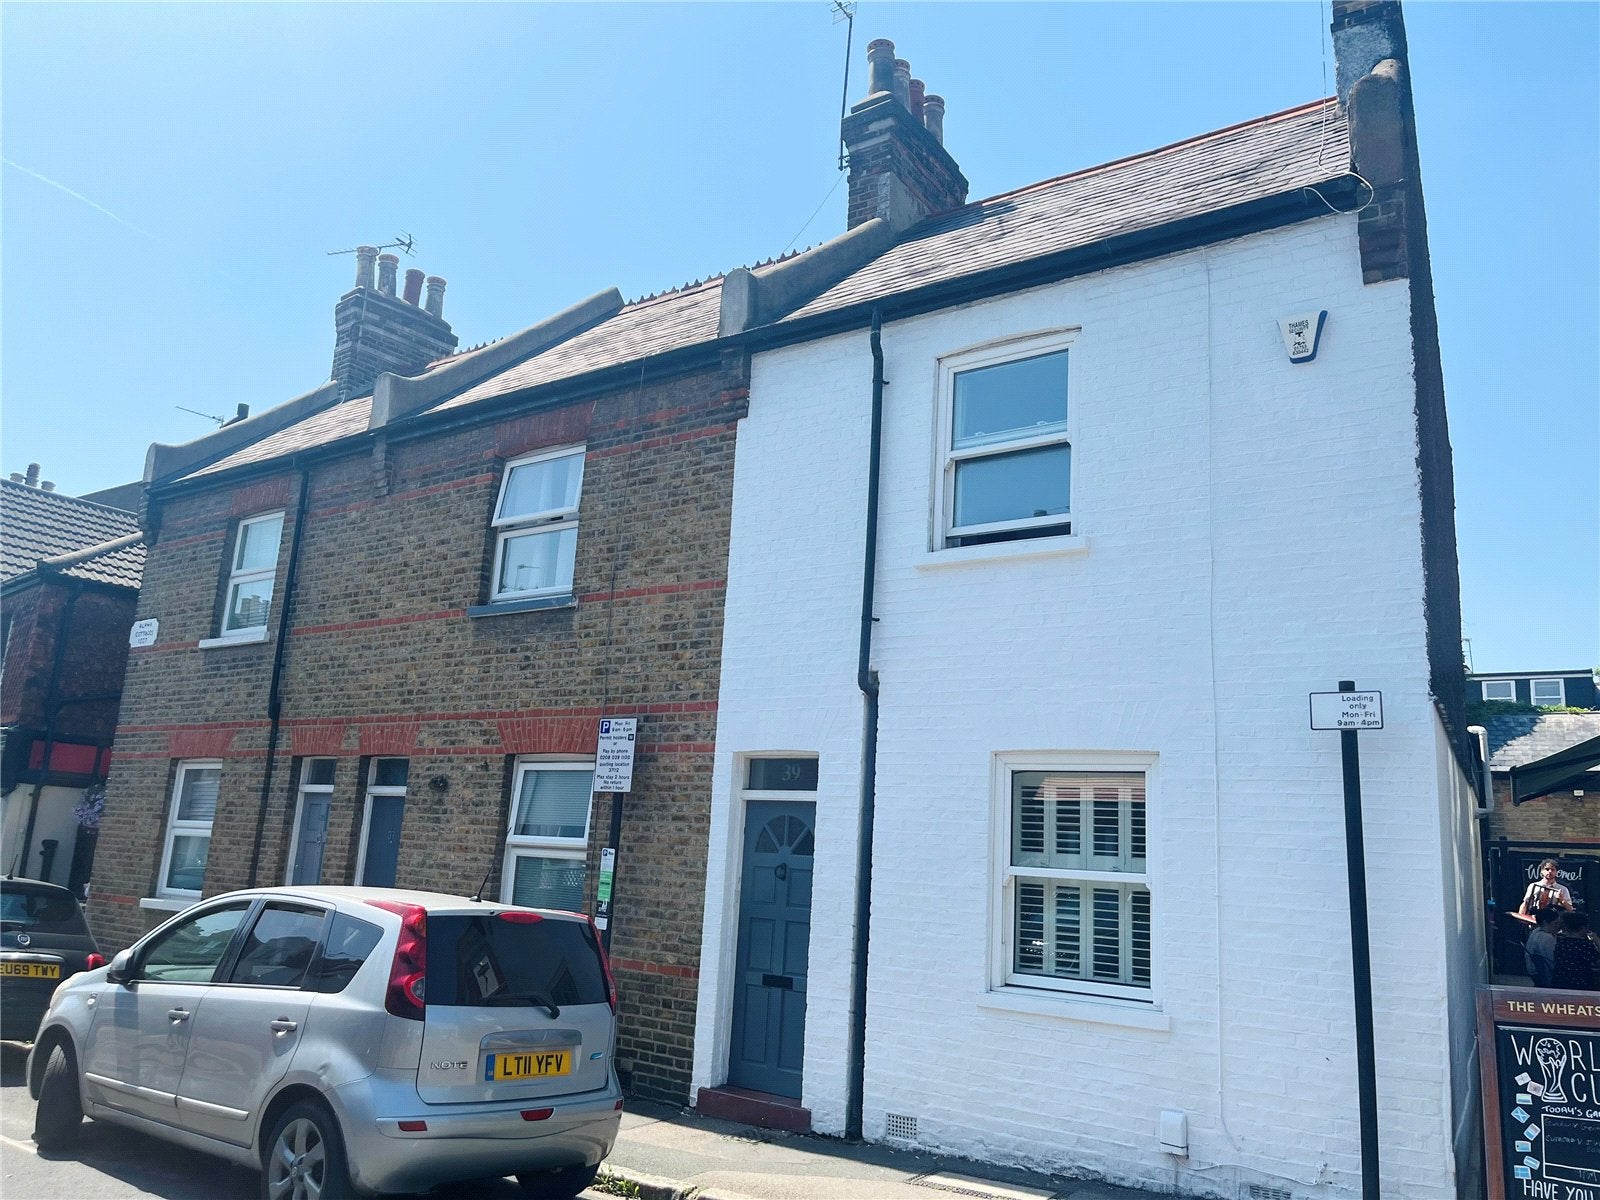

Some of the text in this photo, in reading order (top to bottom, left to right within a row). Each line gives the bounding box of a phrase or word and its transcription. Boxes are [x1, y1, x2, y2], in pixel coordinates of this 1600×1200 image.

[1288, 320, 1309, 329] THAMES
[602, 722, 609, 732] P
[782, 764, 800, 781] 39
[0, 964, 57, 977] EU69 TWY
[1507, 1001, 1535, 1013] THE
[430, 1060, 468, 1070] NOTE
[503, 1054, 563, 1076] LT11 YFV
[1541, 1105, 1600, 1119] TODAY'S GA
[1523, 1179, 1559, 1200] HAVE
